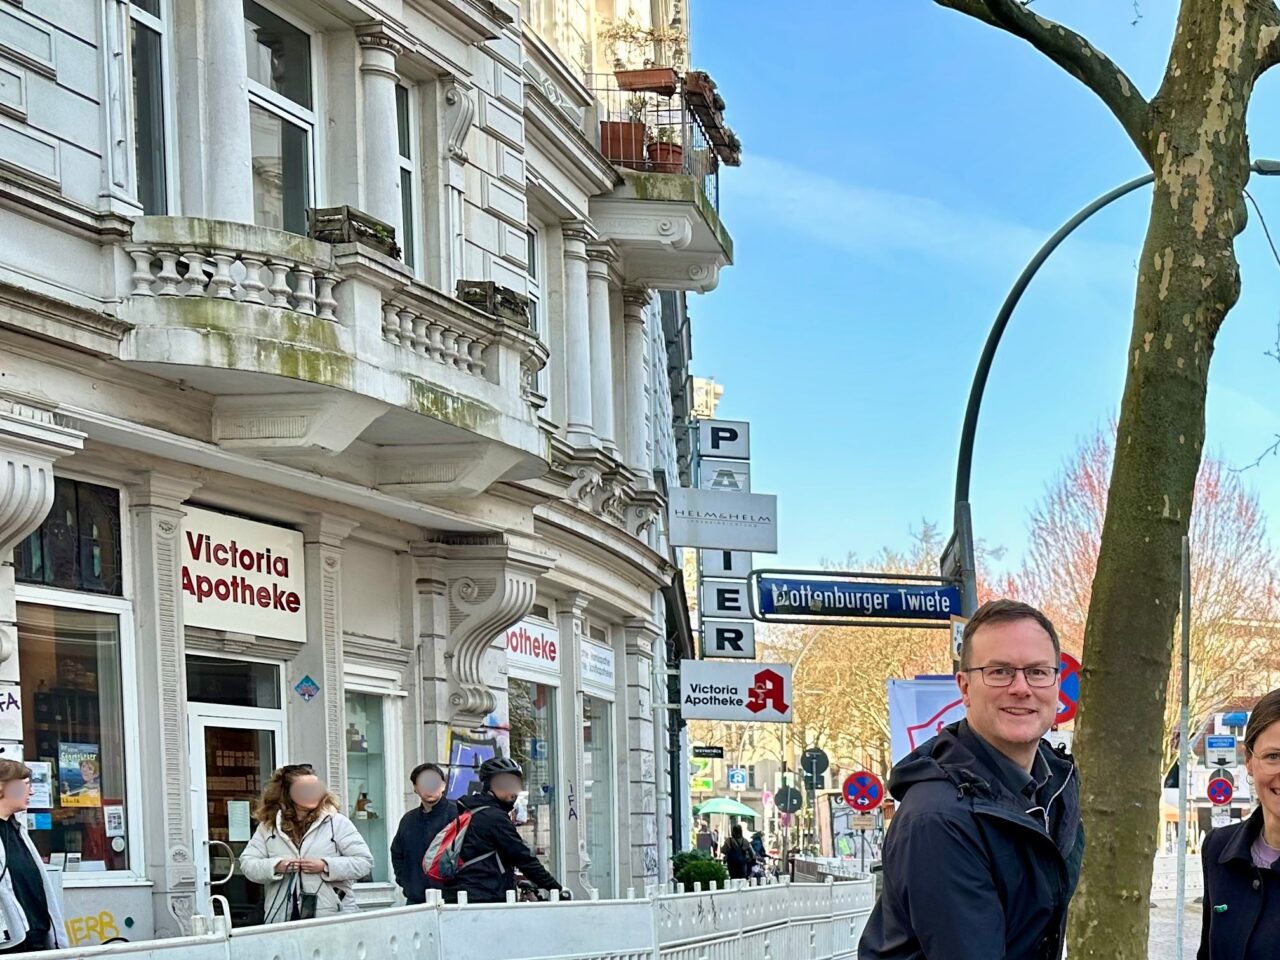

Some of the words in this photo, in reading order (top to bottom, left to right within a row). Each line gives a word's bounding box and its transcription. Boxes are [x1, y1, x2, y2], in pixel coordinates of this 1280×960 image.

[675, 509, 771, 522] HELM&HELM
[186, 530, 289, 578] Victoria
[181, 565, 301, 613] Apotheke
[897, 588, 950, 612] Twiete
[506, 627, 557, 662] otheke
[684, 694, 744, 707] Apotheke
[689, 683, 738, 695] Victoria
